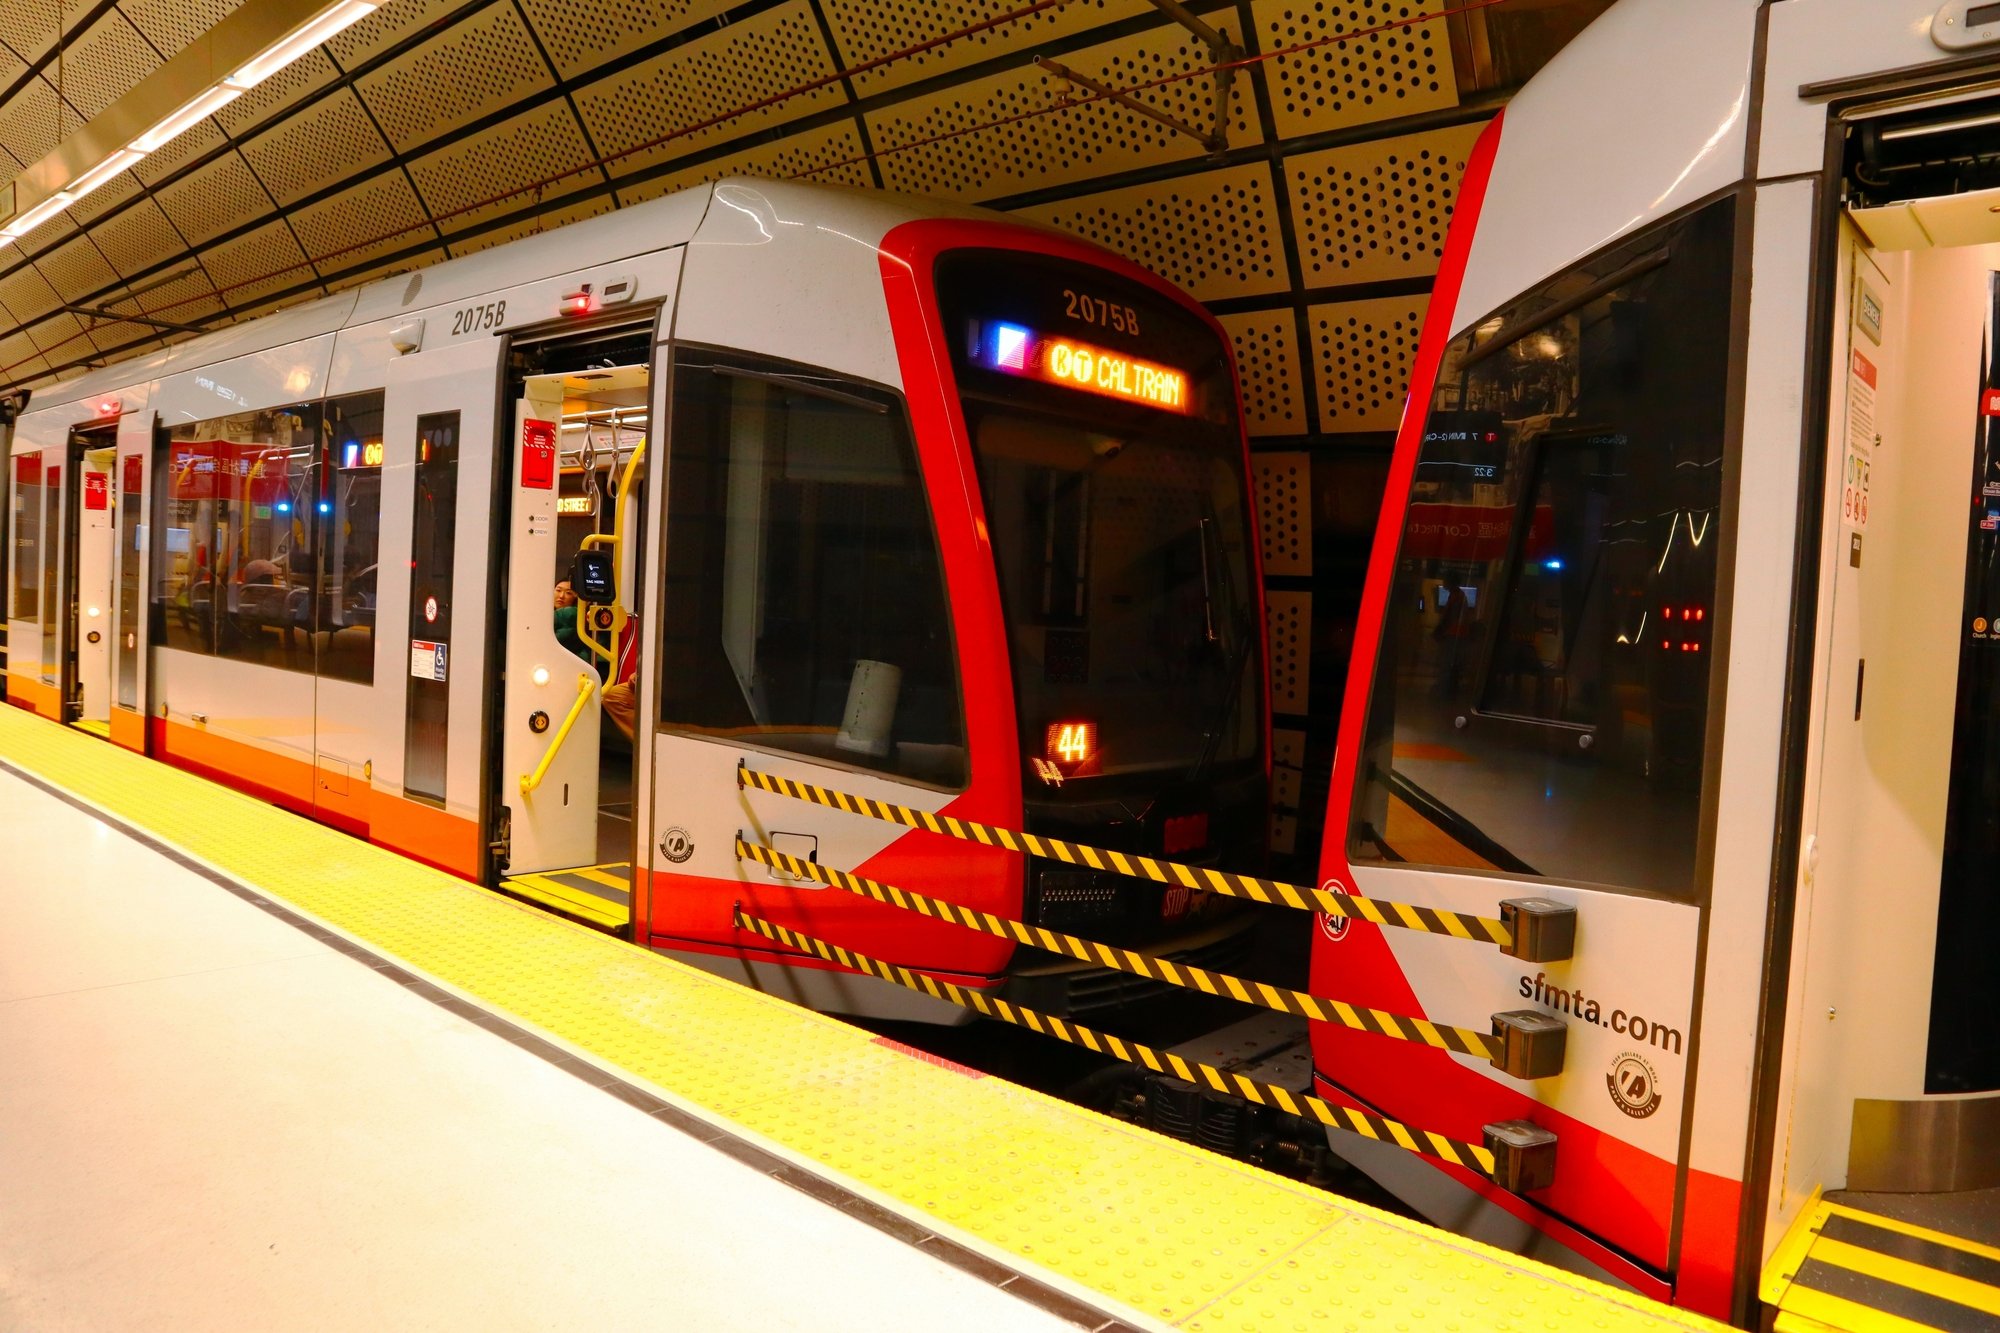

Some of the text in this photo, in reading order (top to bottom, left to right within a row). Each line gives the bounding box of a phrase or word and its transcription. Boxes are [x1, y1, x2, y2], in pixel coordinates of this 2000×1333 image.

[452, 300, 506, 337] 2075B
[1063, 288, 1140, 336] 2075B
[1863, 298, 1880, 327] SIEMENS
[1096, 355, 1181, 406] CALTRAIN
[1058, 725, 1086, 762] 44
[1163, 888, 1189, 917] STOP
[1518, 972, 1683, 1056] sfmta.com
[1621, 1051, 1642, 1060] DOLLARS
